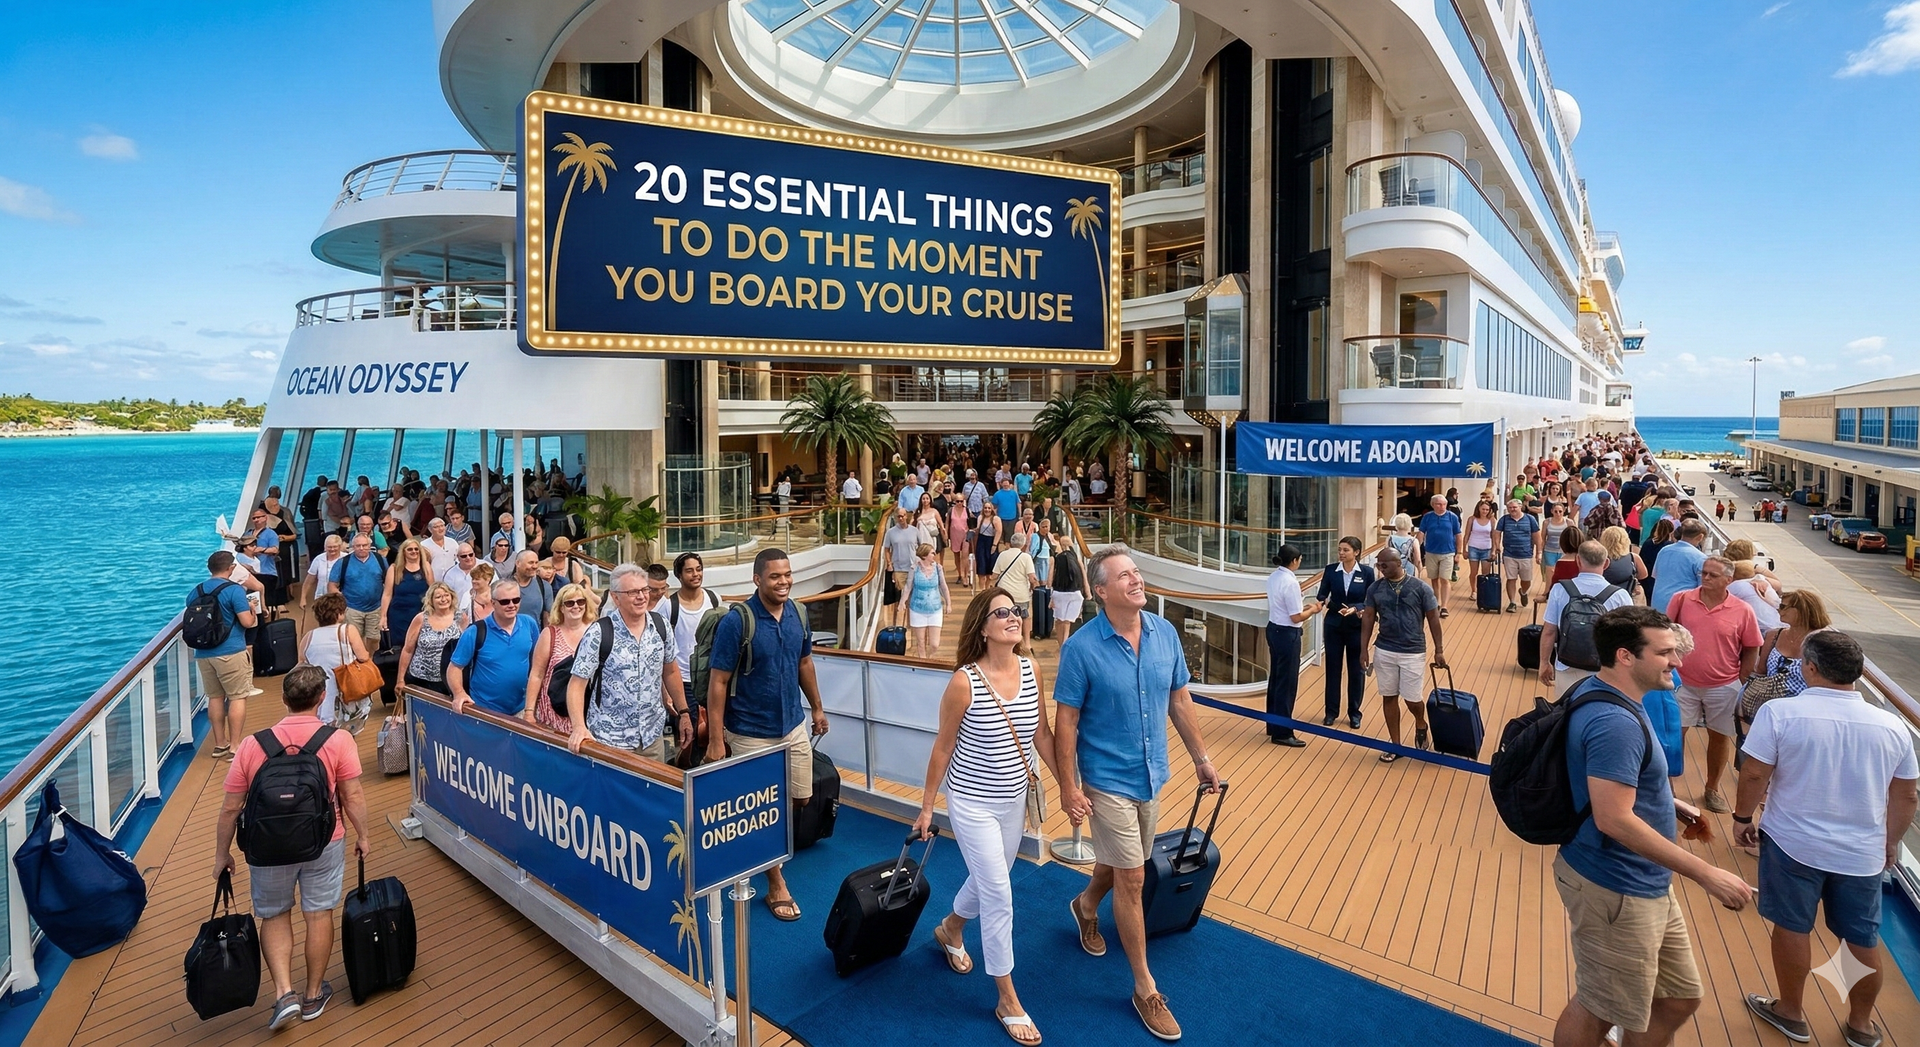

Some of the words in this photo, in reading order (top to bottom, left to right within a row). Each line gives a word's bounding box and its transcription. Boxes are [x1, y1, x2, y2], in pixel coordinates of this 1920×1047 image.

[634, 161, 687, 204] 20
[703, 169, 916, 226] ESSENTIAL
[926, 193, 1054, 238] THINGS
[654, 217, 713, 257] TO
[728, 223, 789, 262] DO
[800, 230, 875, 269] THE
[888, 238, 1042, 280] MOMENT
[606, 265, 695, 304] YOU
[709, 274, 846, 312] BOARD
[856, 281, 952, 316] YOUR
[962, 288, 1073, 323] CRUISE
[287, 365, 346, 396] OCEAN
[348, 361, 469, 394] ODYSSEY
[1265, 437, 1362, 463] WELCOME
[1367, 439, 1461, 463] ABOARD!
[433, 740, 517, 821] WELCOME
[521, 782, 652, 891] ONBOARD
[700, 784, 779, 825] WELCOME
[702, 807, 779, 850] ONBOARD
